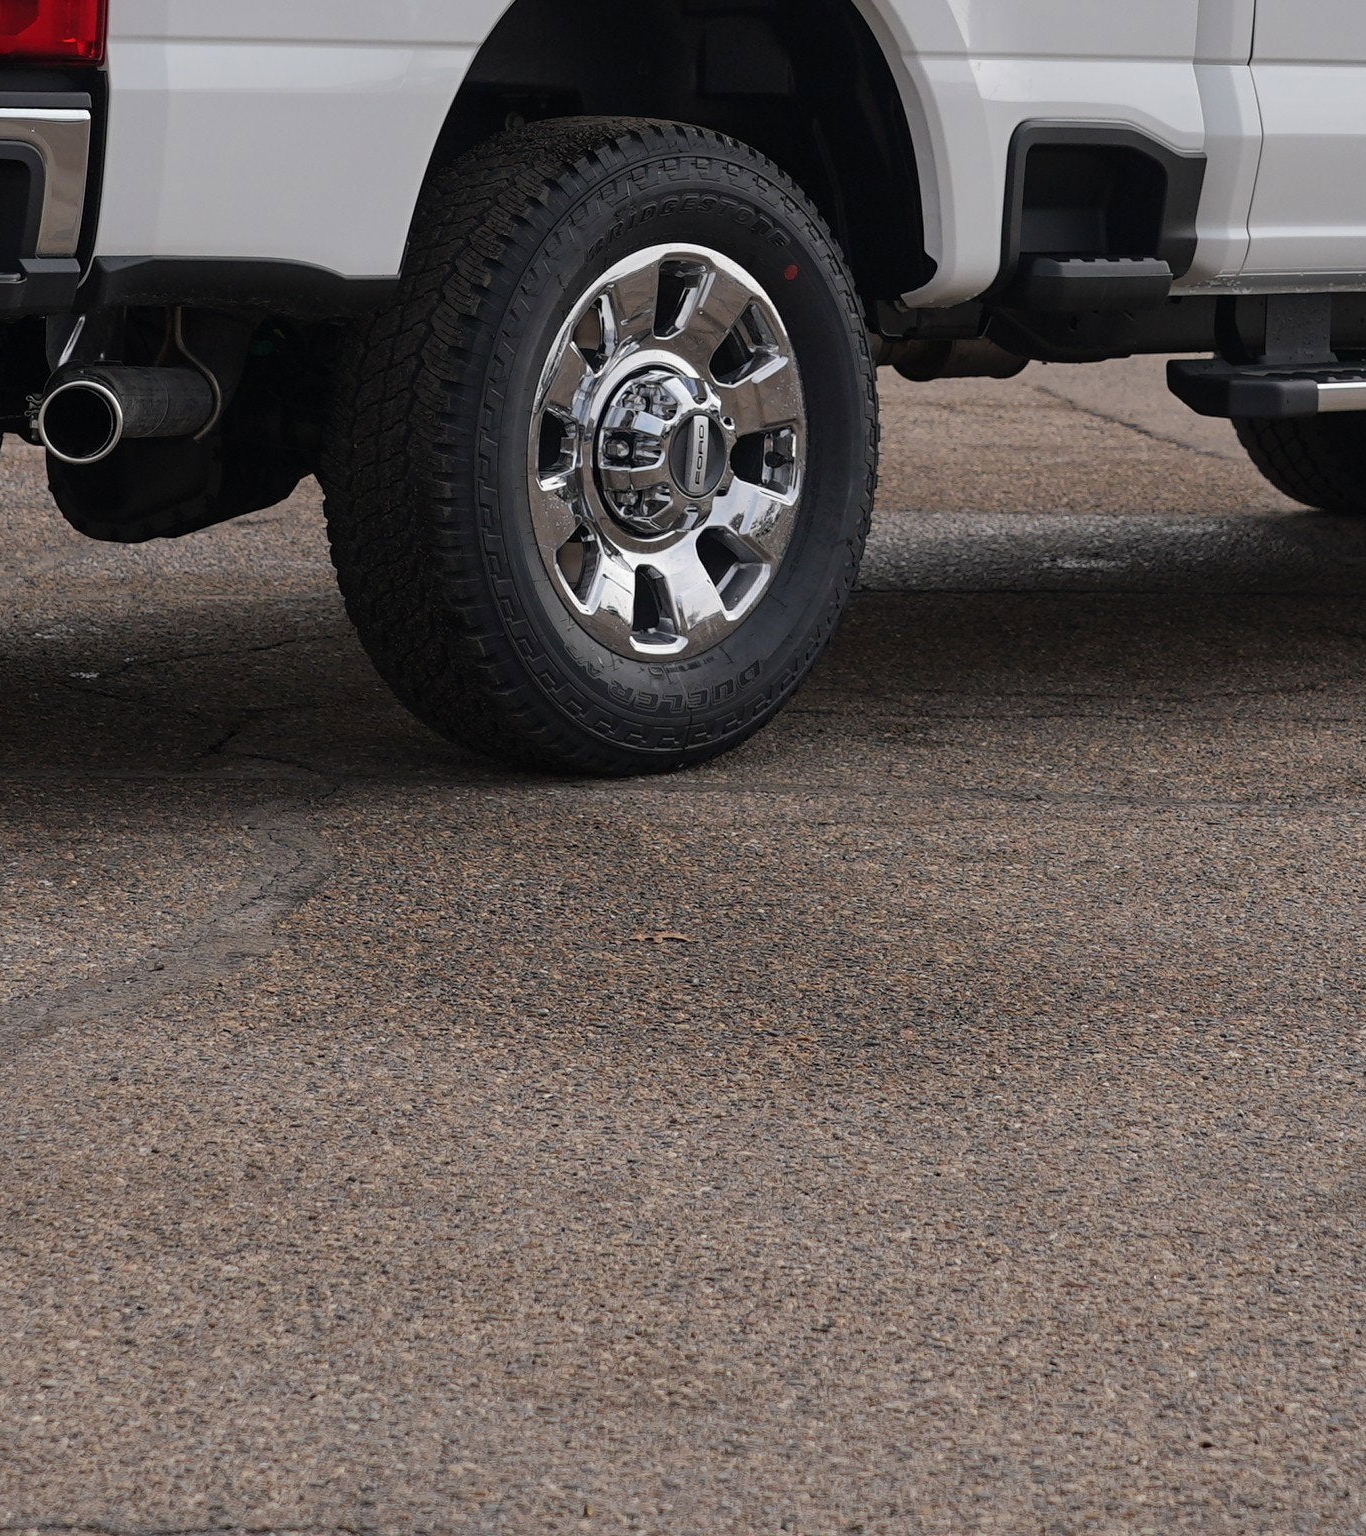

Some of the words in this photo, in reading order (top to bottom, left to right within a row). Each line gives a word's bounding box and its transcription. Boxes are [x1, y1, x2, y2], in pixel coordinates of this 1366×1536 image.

[586, 192, 792, 263] BRIDGESTONE
[694, 424, 705, 485] FORD
[606, 658, 763, 714] DUELER
